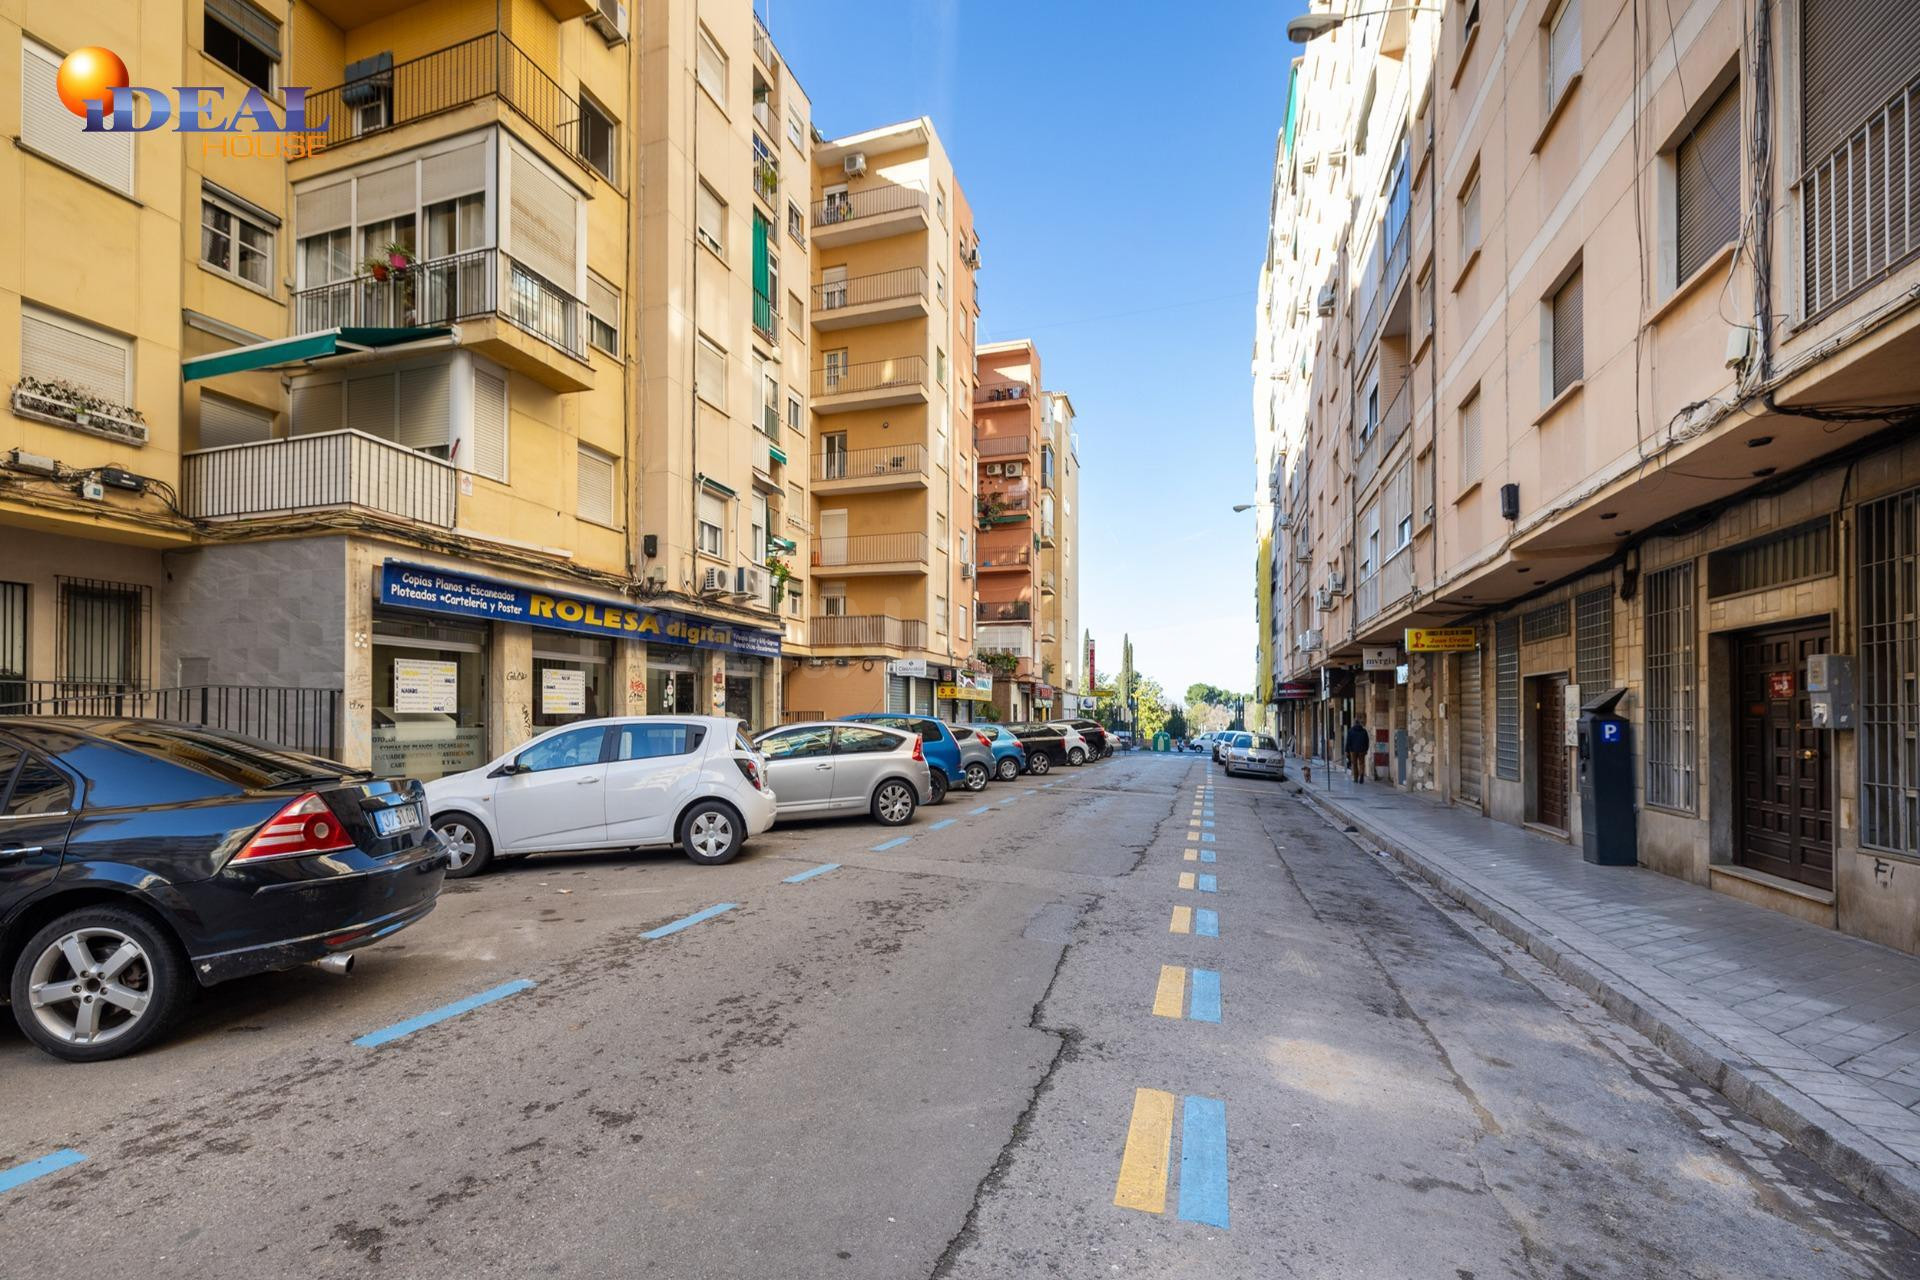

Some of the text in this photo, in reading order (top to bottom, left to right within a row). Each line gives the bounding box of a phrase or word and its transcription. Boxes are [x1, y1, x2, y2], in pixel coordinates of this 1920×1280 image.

[402, 572, 432, 588] Copias
[435, 578, 463, 593] Planos
[391, 584, 437, 602] Ploteados
[490, 603, 496, 613] y
[497, 602, 523, 615] Poster
[529, 594, 660, 634] ROLESA
[666, 622, 732, 645] digital
[1604, 724, 1617, 739] P
